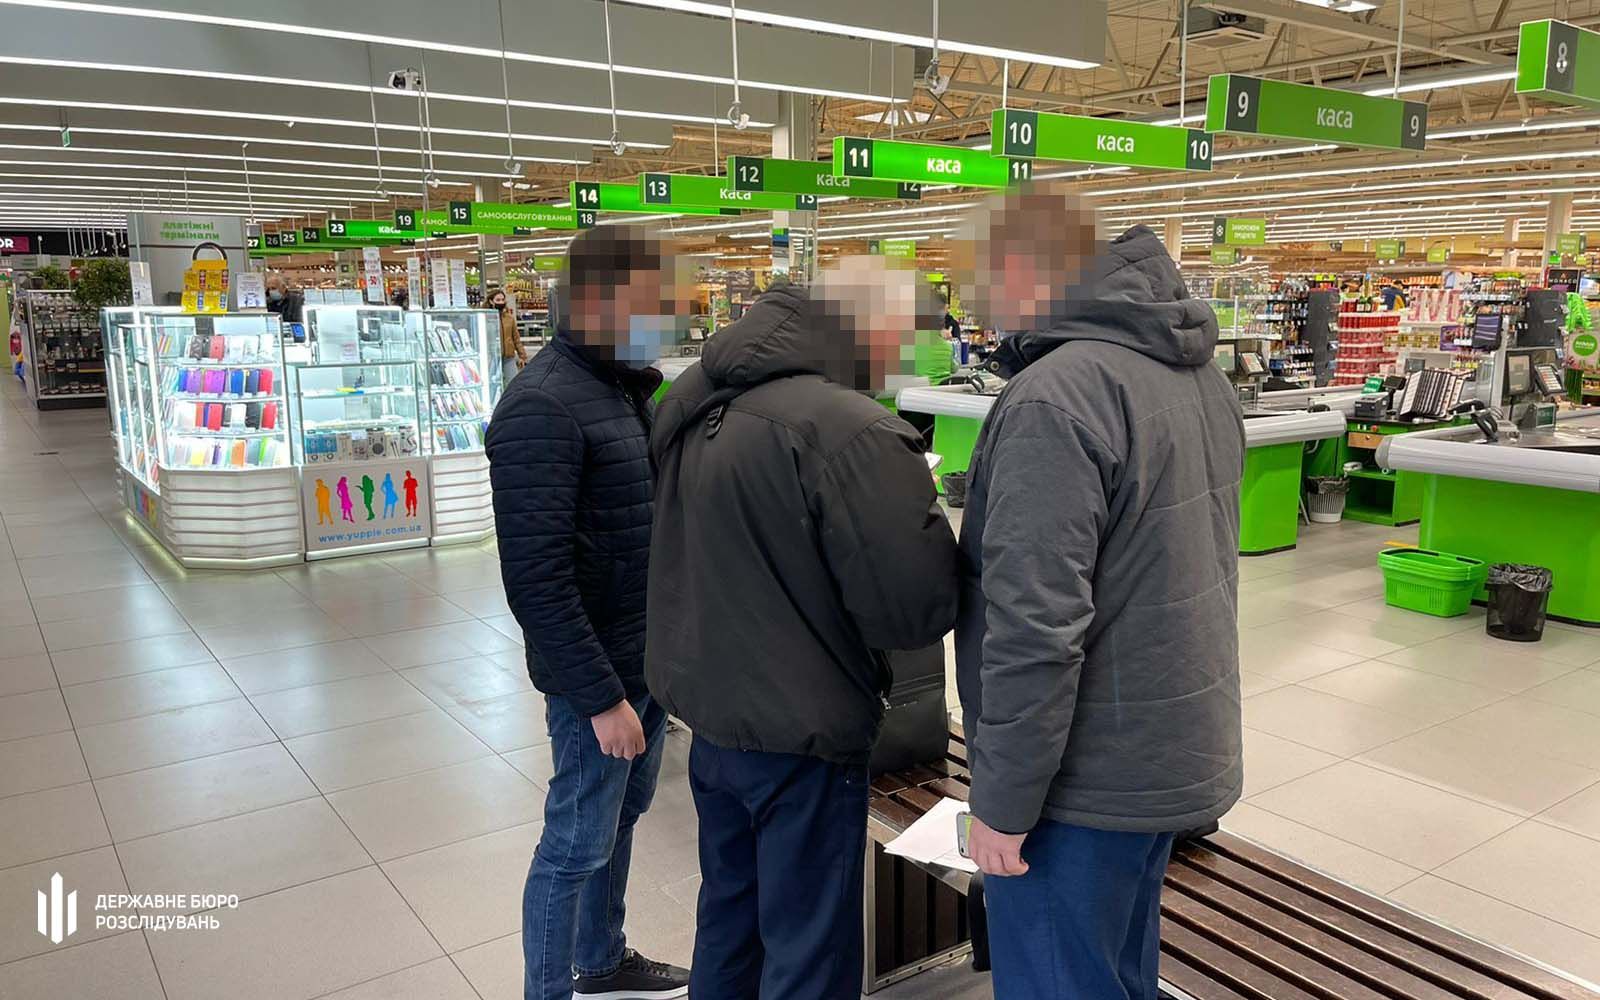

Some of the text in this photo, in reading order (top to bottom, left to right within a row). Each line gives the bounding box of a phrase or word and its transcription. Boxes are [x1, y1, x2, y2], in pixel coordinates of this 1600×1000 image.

[1557, 42, 1568, 74] 8
[1237, 91, 1419, 136] 9 каса 9
[1009, 122, 1209, 161] 10 каса 10
[849, 147, 1028, 180] 11 каса 11
[739, 165, 759, 183] 12
[579, 189, 598, 203] 14
[649, 181, 667, 197] 13
[398, 215, 412, 226] 19
[452, 207, 593, 223] 15 САМООБСЛУГОВУВАННЯ 18
[305, 230, 317, 240] 24
[330, 223, 344, 233] 23
[248, 239, 259, 247] 27
[267, 236, 279, 245] 26
[283, 233, 295, 243] 25
[319, 524, 422, 543] www.yuppie.com.ua
